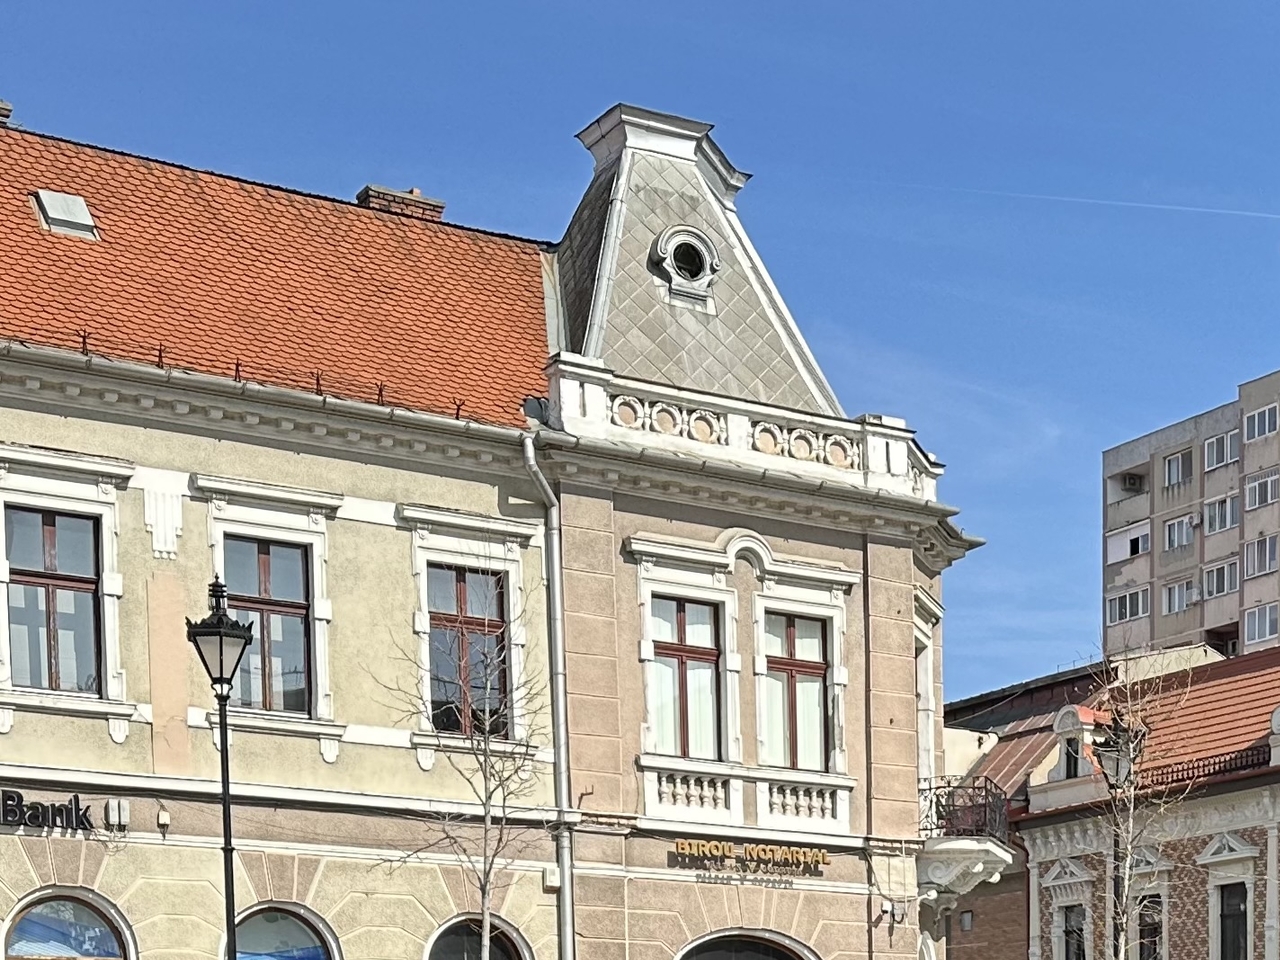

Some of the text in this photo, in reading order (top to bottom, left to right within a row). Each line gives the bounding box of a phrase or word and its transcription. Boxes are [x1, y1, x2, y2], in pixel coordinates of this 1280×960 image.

[0, 789, 95, 830] Bank
[675, 838, 832, 866] BIROU NOTARIAL
